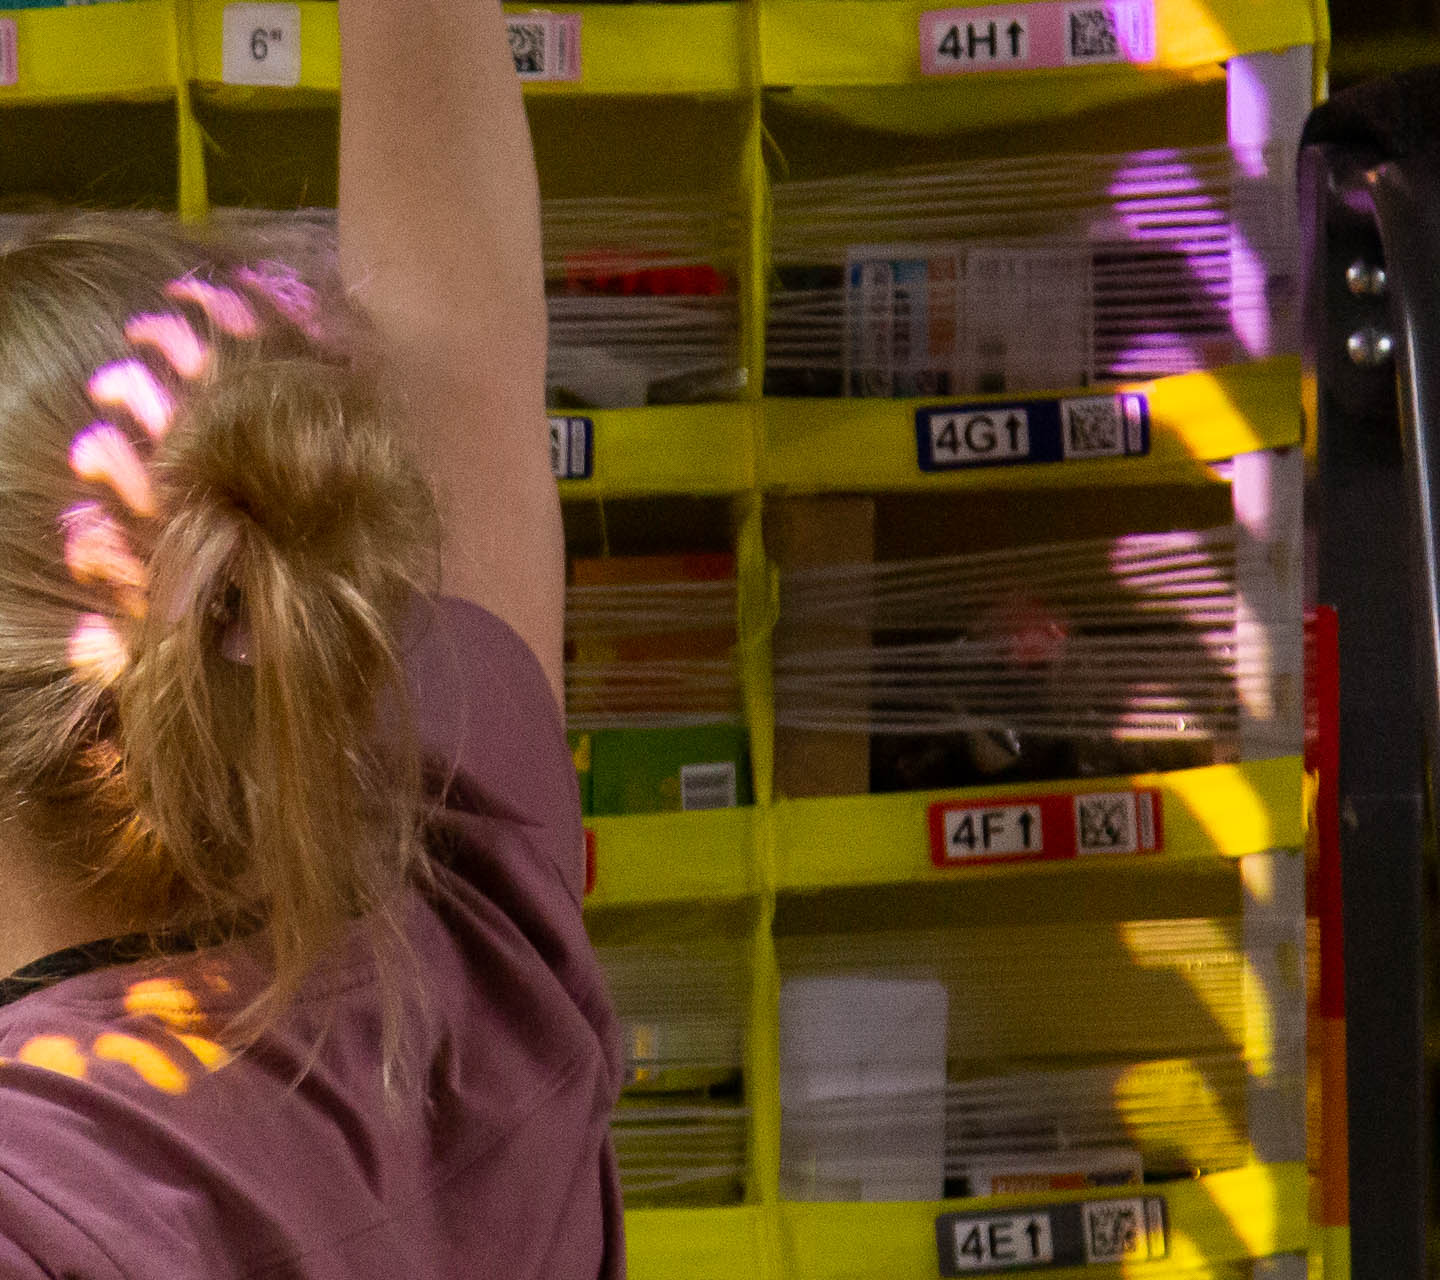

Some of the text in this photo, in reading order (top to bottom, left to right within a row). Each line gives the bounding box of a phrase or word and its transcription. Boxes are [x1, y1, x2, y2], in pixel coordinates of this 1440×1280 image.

[250, 26, 283, 61] 6"
[937, 22, 997, 60] 4H
[935, 413, 998, 455] 4G
[952, 811, 1004, 850] 4F
[960, 1221, 1015, 1262] 4E
